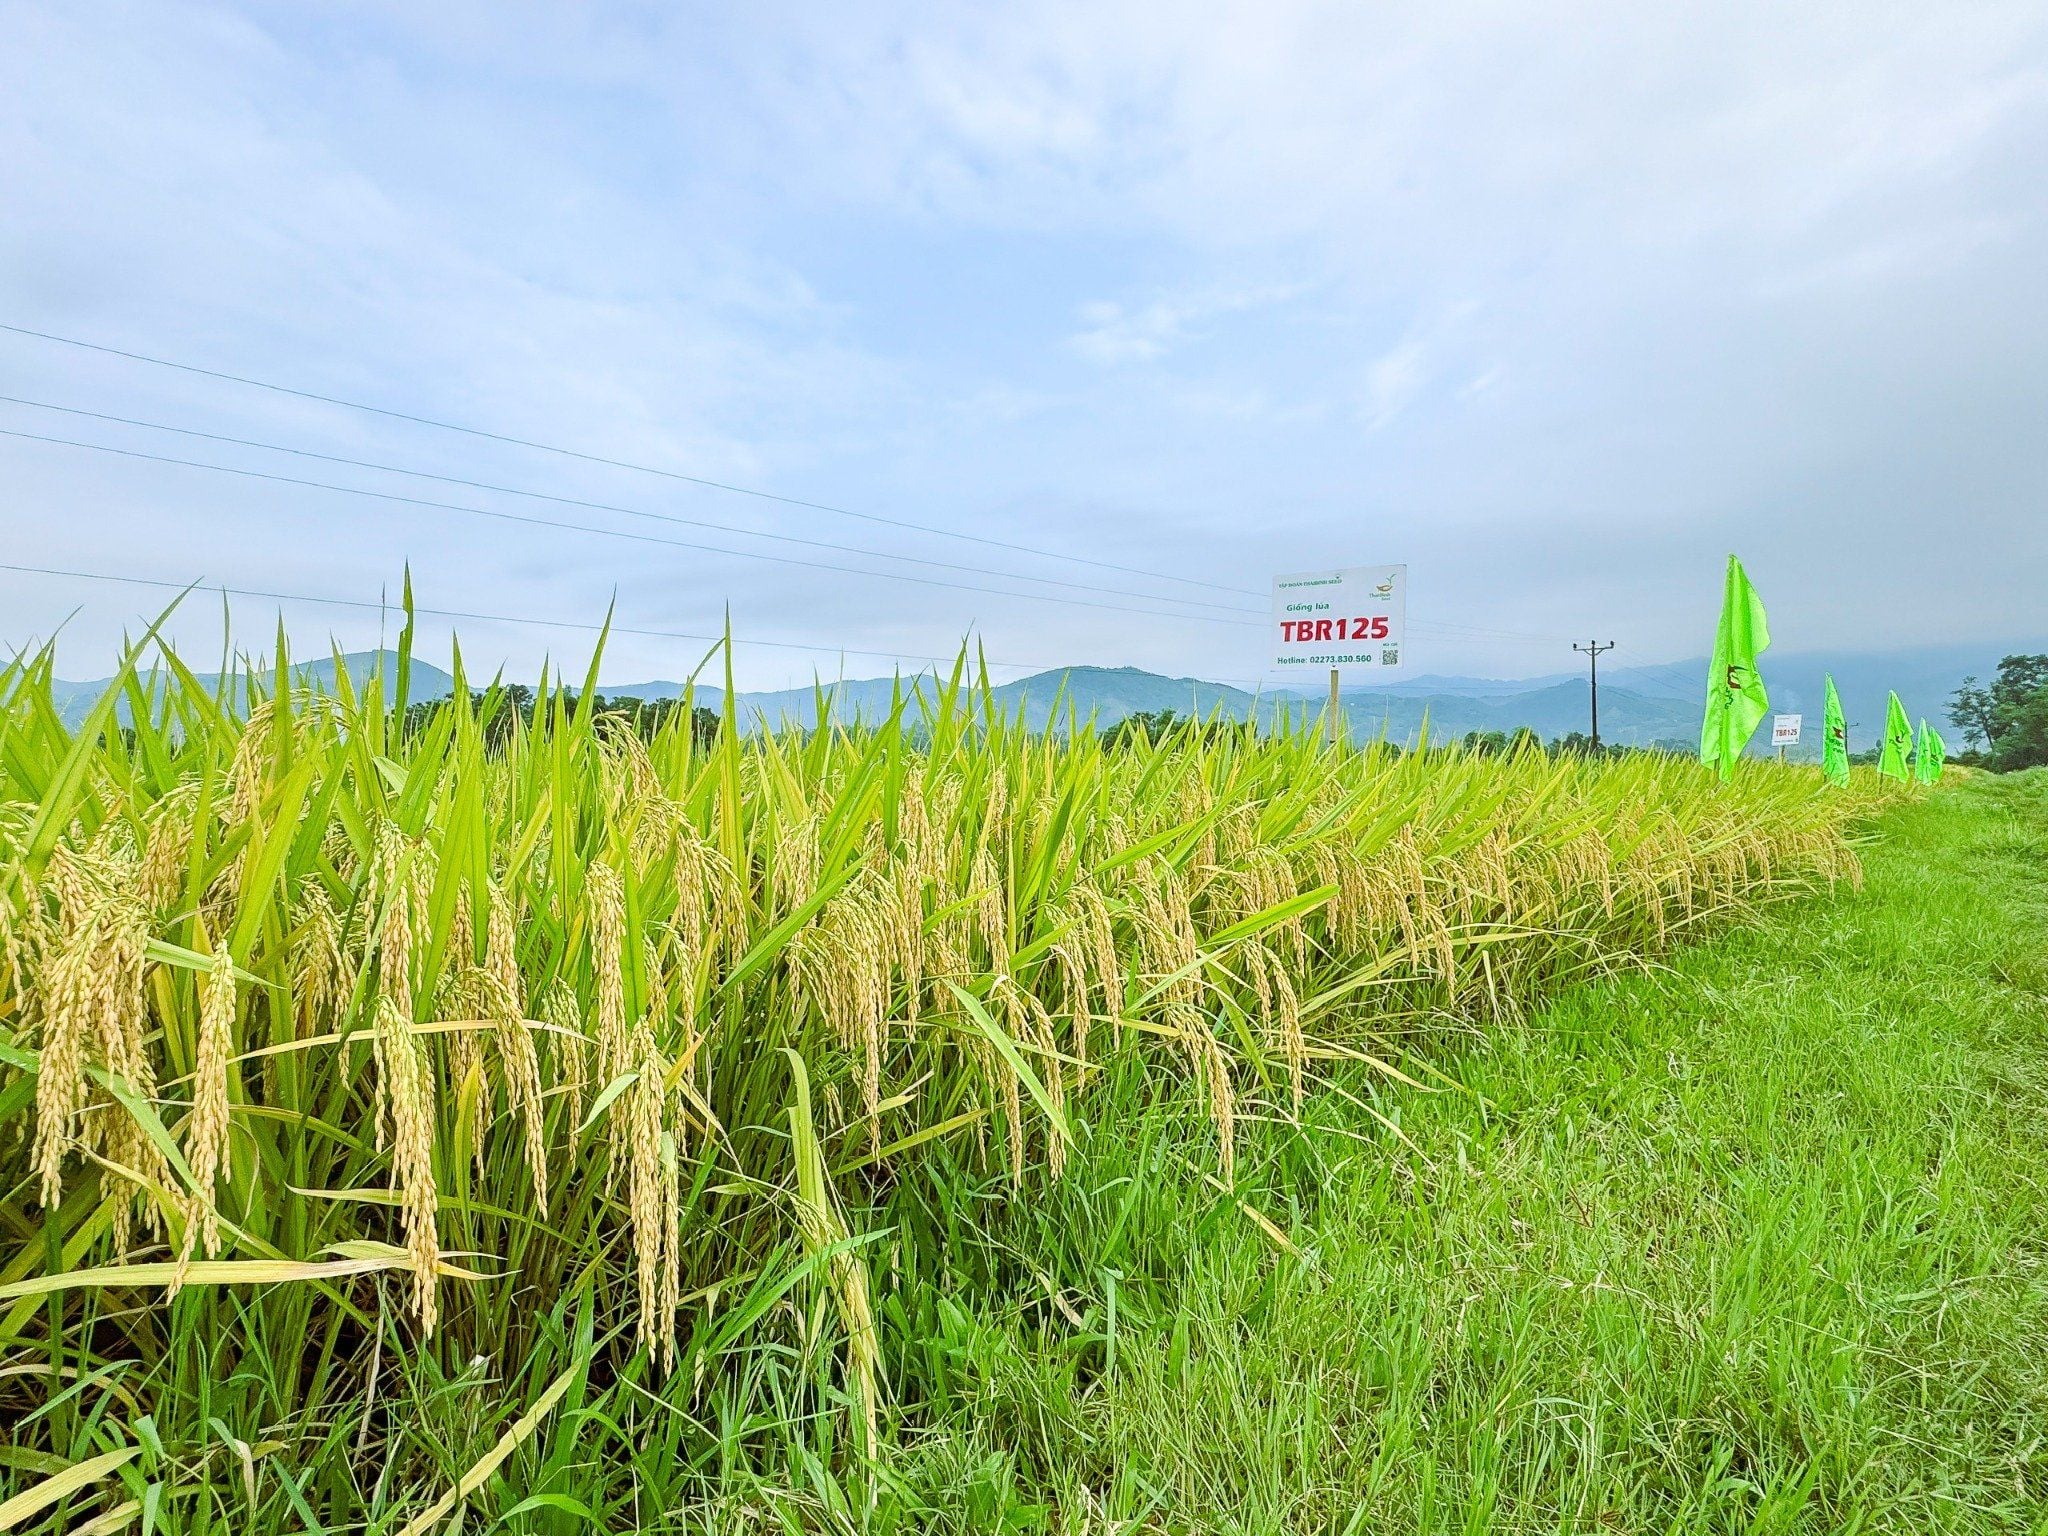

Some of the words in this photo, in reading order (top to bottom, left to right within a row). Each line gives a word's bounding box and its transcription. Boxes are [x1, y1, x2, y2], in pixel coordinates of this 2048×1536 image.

[1286, 602, 1313, 612] Giống
[1280, 616, 1389, 642] TBR125
[1277, 656, 1308, 665] Hotline:
[1310, 655, 1372, 664] 02273.830.560
